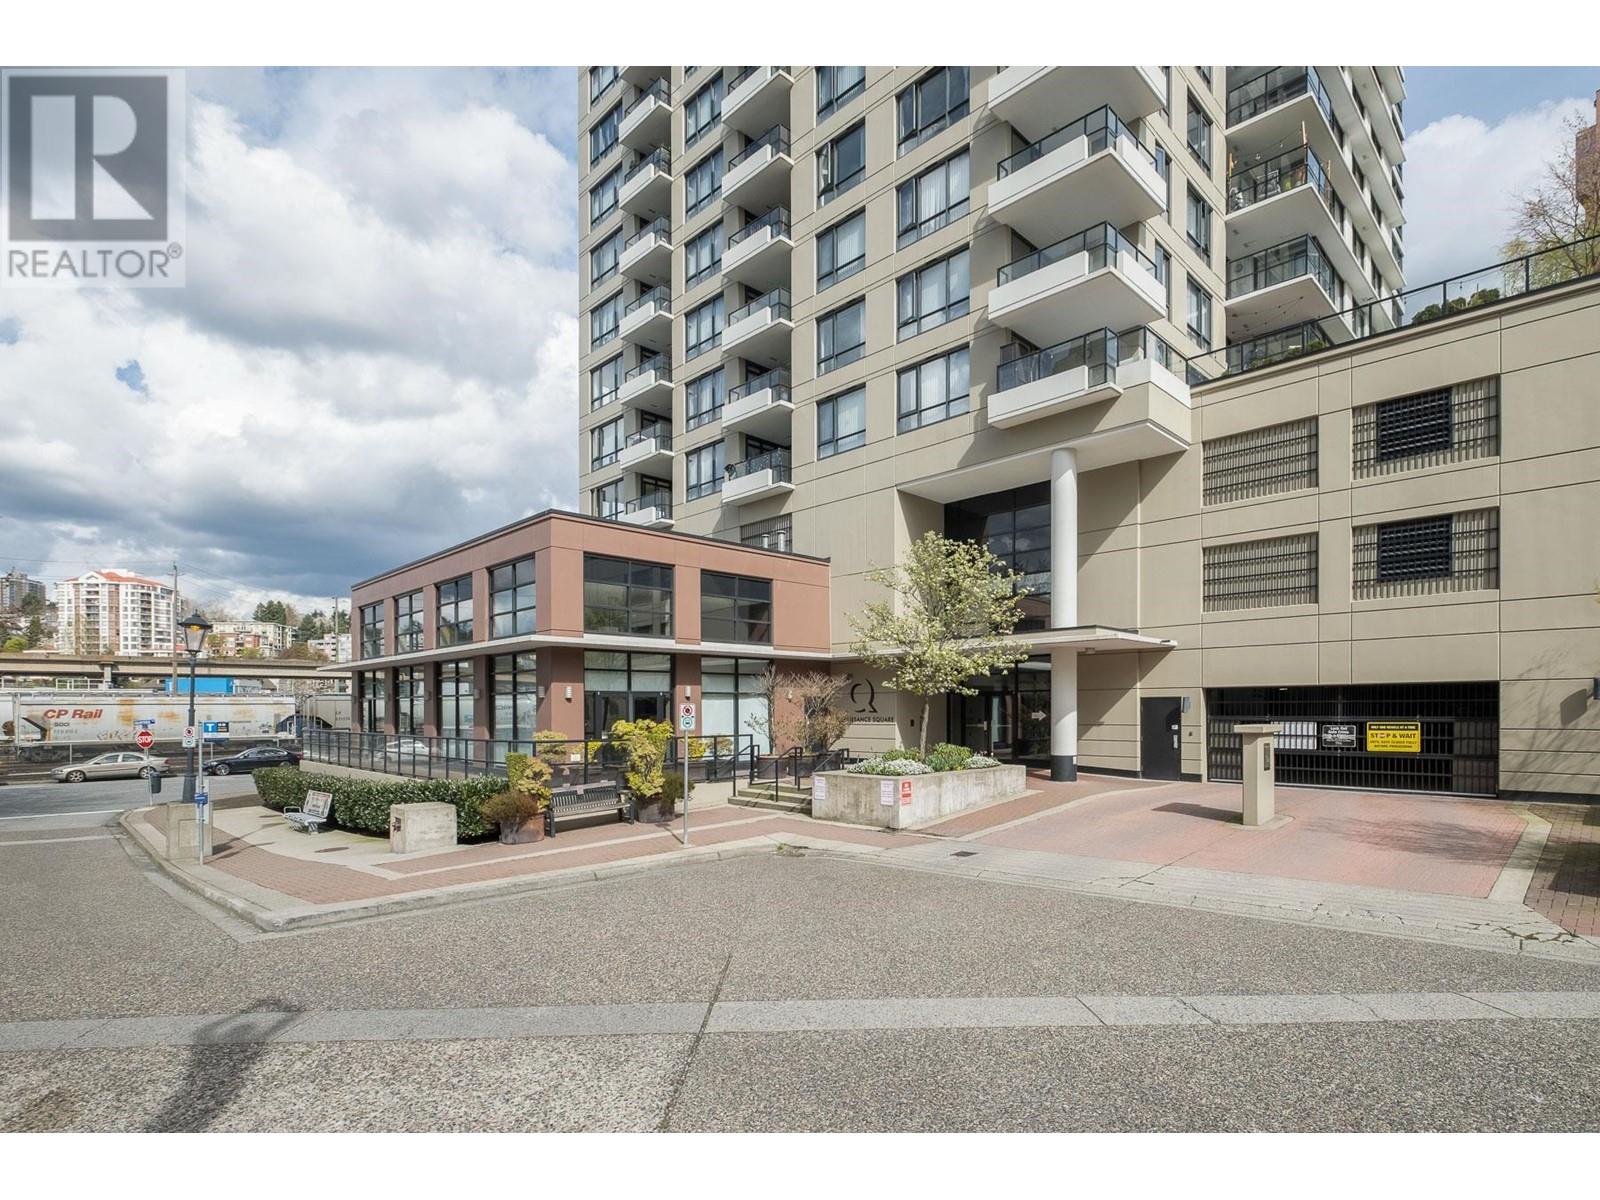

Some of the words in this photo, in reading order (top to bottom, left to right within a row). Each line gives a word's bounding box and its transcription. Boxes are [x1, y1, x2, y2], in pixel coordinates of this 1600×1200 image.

[43, 708, 69, 719] CP
[71, 708, 103, 719] Rail
[137, 735, 153, 743] STOP
